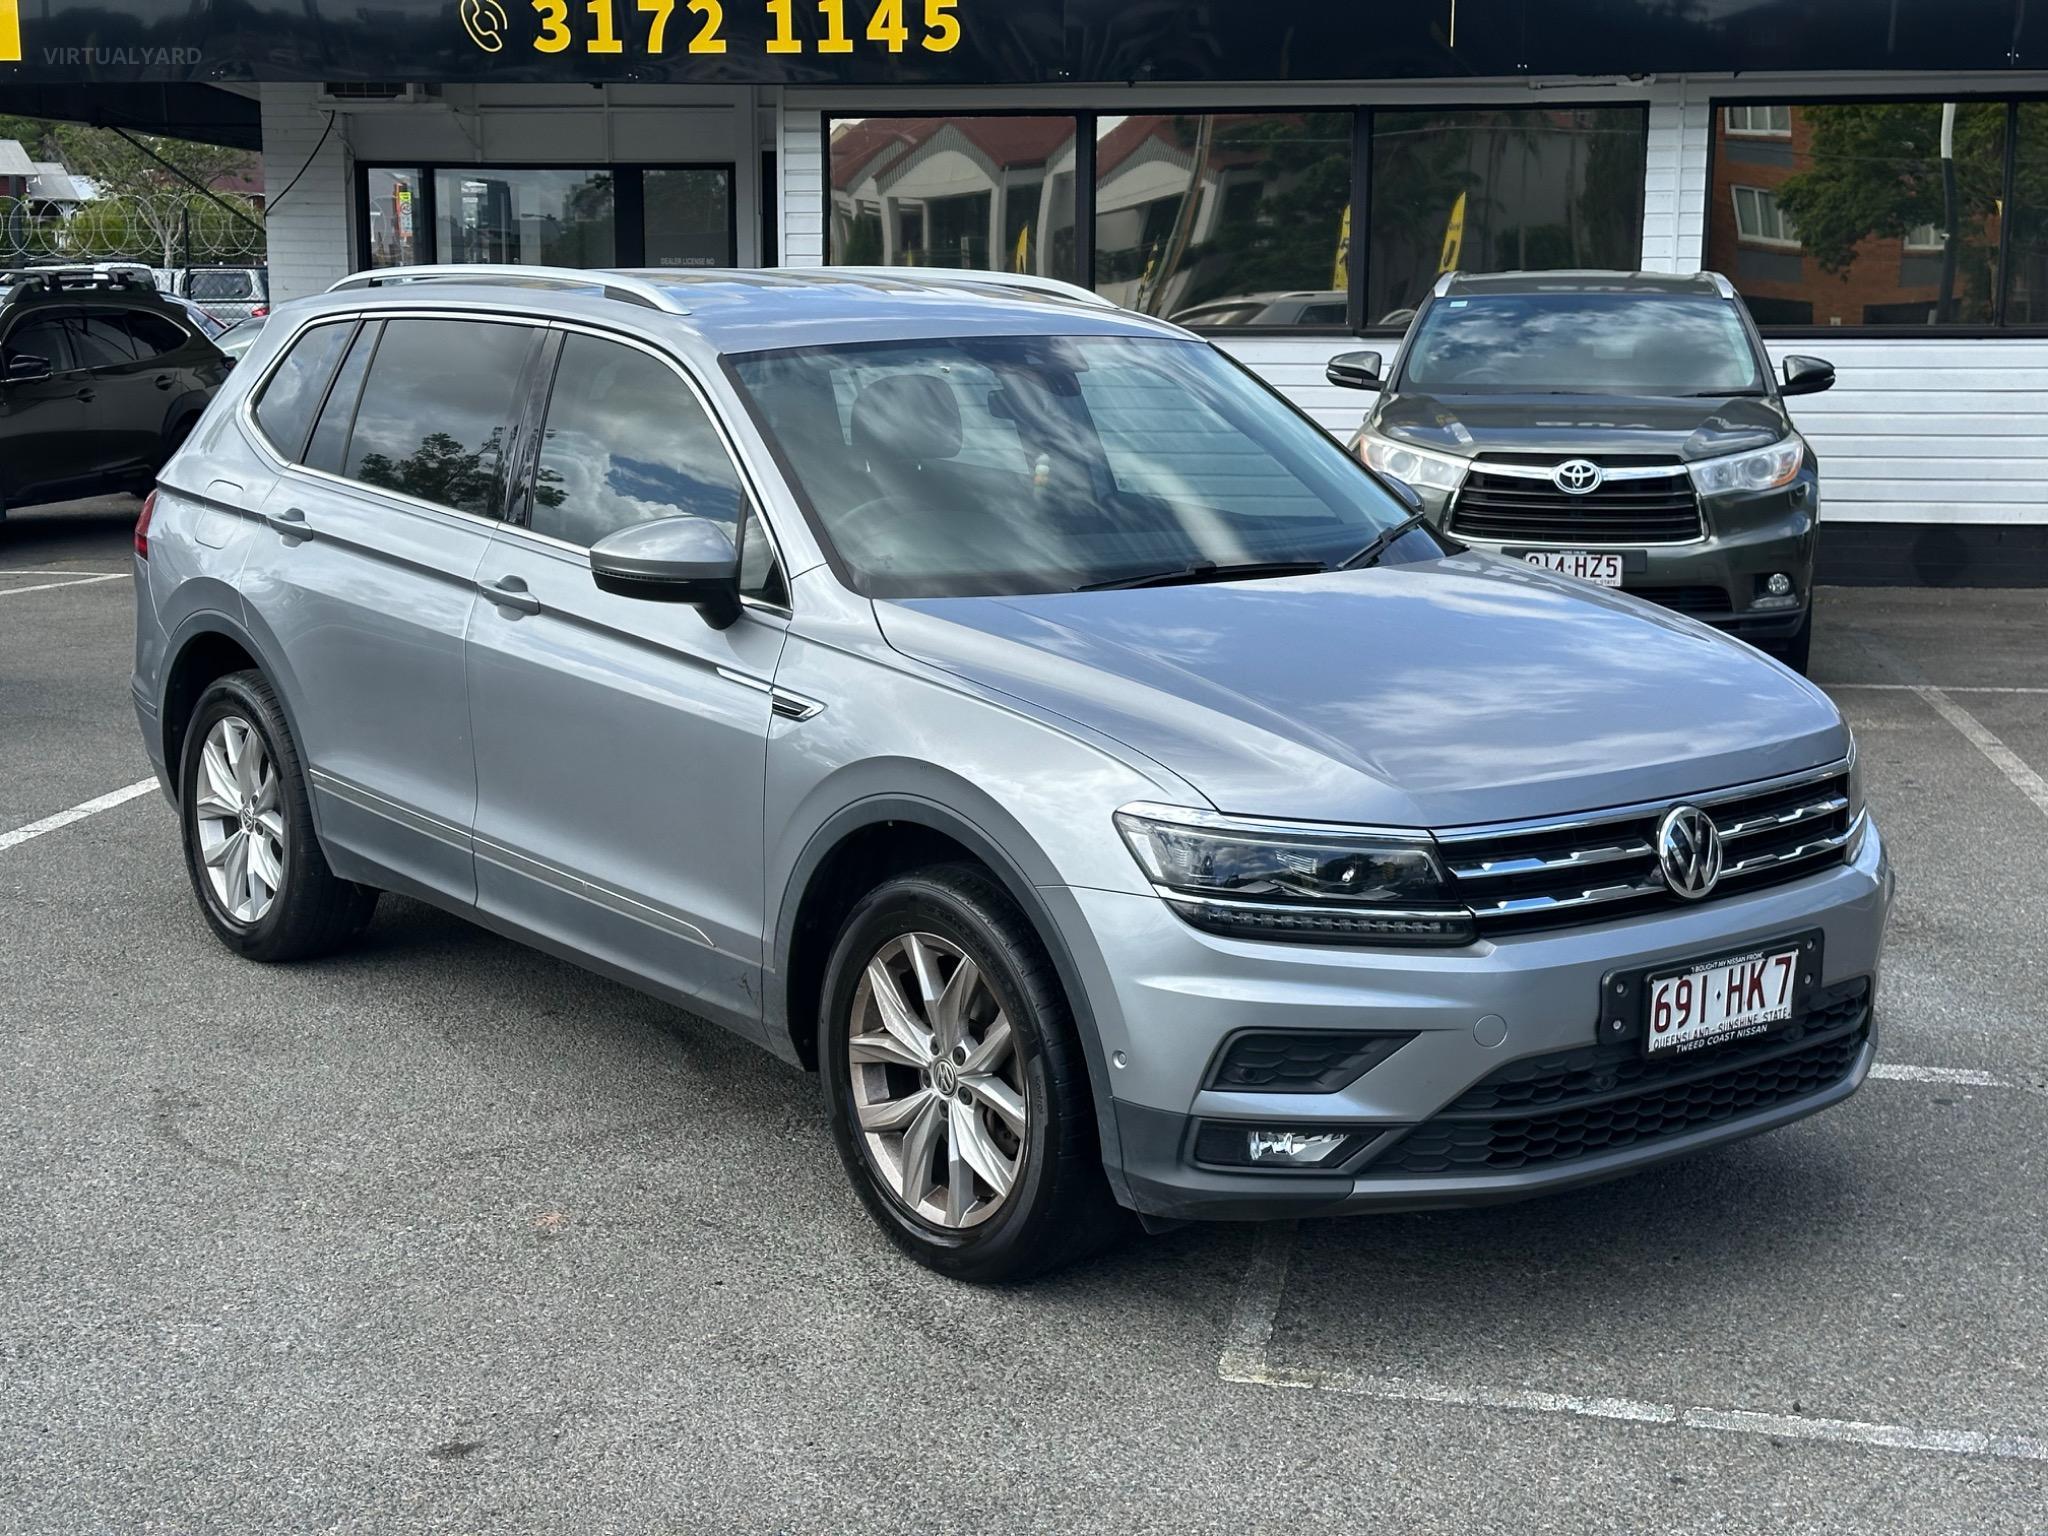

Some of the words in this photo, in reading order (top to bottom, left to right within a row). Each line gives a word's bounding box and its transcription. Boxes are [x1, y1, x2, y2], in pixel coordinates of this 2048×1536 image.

[531, 0, 728, 54] 3172
[766, 0, 963, 54] 1145
[1695, 961, 1718, 972] BOUGHT
[1726, 956, 1746, 965] NISSAN
[1654, 1026, 1710, 1049] QUEENSLAND
[1718, 1014, 1758, 1031] SUNSHINE
[1763, 1007, 1788, 1022] STATE
[1676, 1039, 1705, 1054] TWEED
[1707, 1031, 1735, 1046] COAST
[1736, 1024, 1768, 1038] NISSAN
